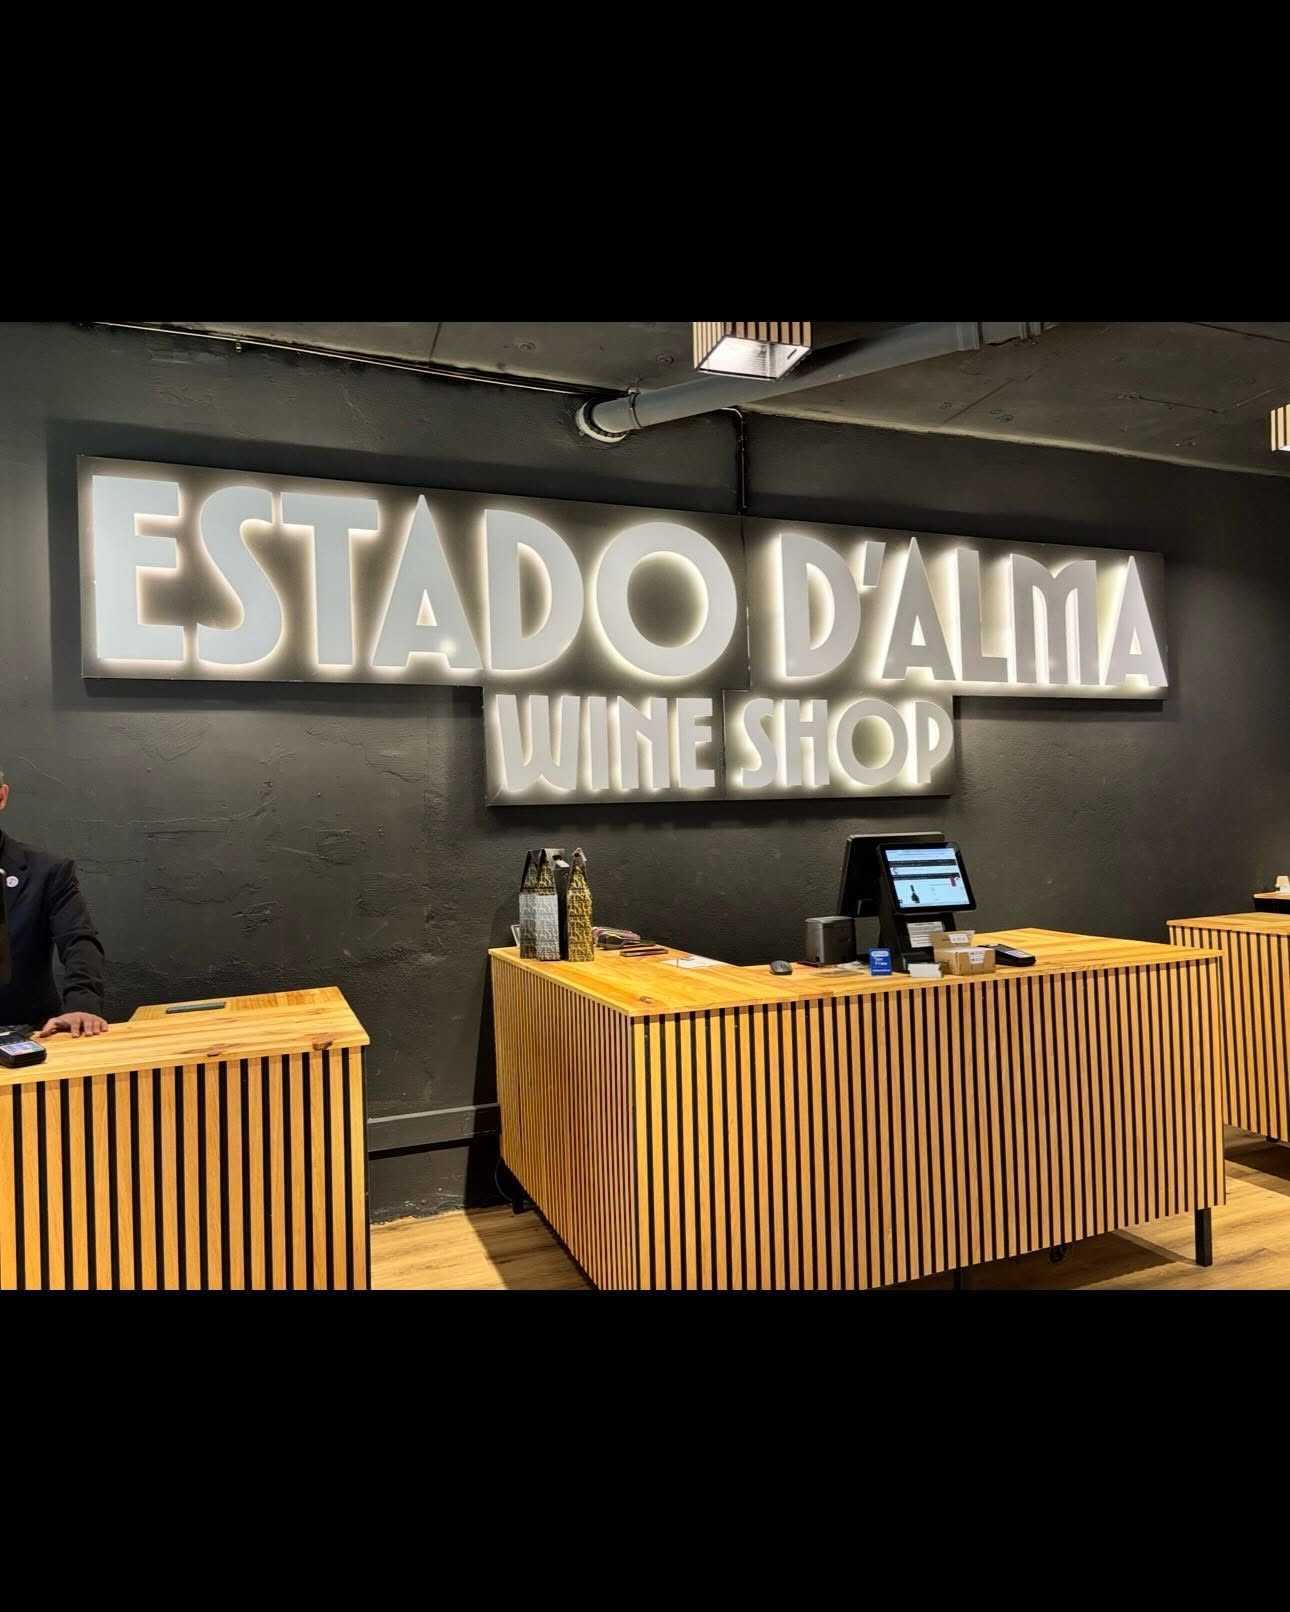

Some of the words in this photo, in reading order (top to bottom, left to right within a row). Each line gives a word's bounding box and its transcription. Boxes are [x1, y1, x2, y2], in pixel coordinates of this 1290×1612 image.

[92, 475, 739, 678] ESTADO
[780, 533, 1168, 688] D'ALMA
[496, 694, 715, 792] WINE
[740, 697, 954, 787] SHOP
